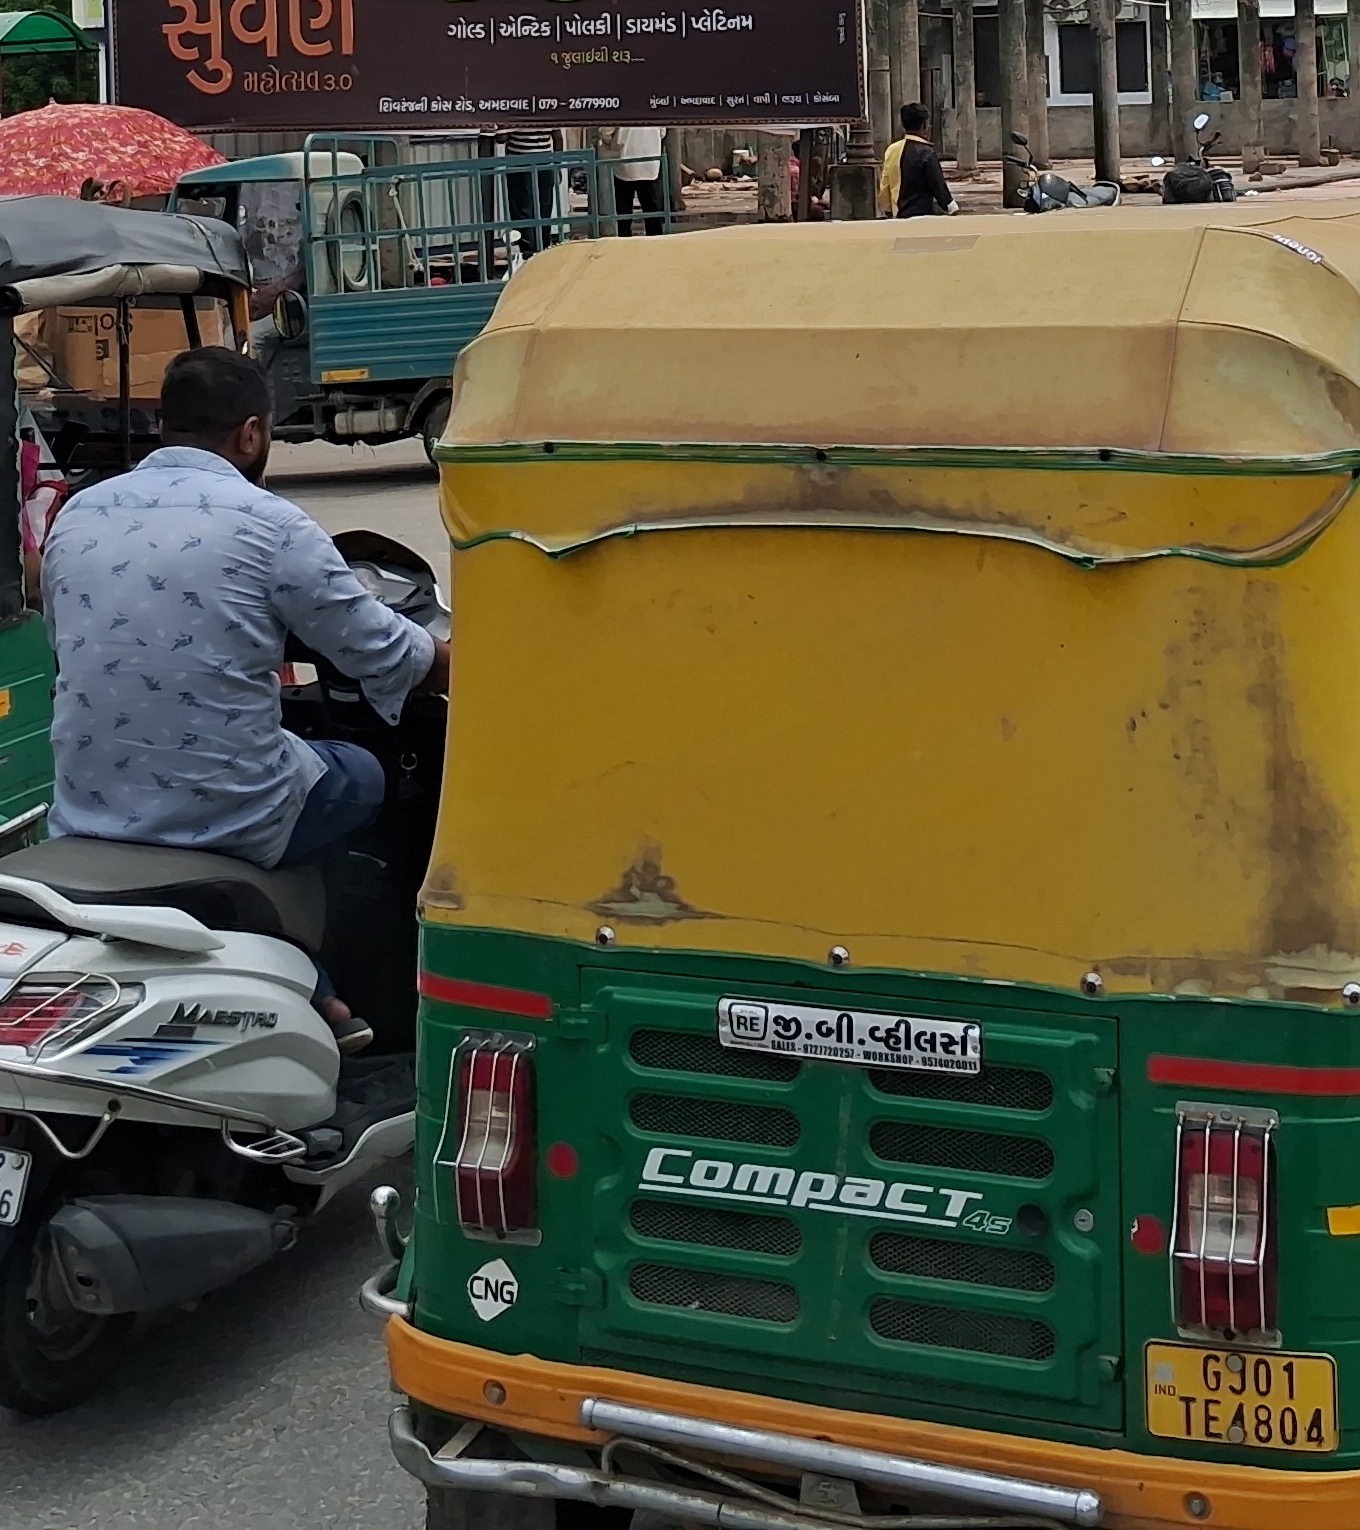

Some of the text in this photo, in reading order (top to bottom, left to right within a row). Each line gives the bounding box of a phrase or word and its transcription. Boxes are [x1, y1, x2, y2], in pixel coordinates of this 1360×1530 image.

[447, 9, 754, 40] ગોલ્ડ એન્ટિક પોલકી ડાયમંડ પ્લેટિનમ
[243, 64, 353, 95] મહોત્સવ 3.0
[379, 96, 428, 113] શિવરંજની
[479, 98, 530, 111] અમદાવાદ
[539, 98, 558, 110] 079
[569, 98, 620, 110] 26779900
[736, 1015, 760, 1032] RE
[862, 1050, 914, 1065] WORKSHOP
[469, 1275, 515, 1305] CNG
[1154, 1384, 1177, 1397] IND
[1203, 1354, 1295, 1400] GJ01
[1179, 1396, 1325, 1448] TE4804
